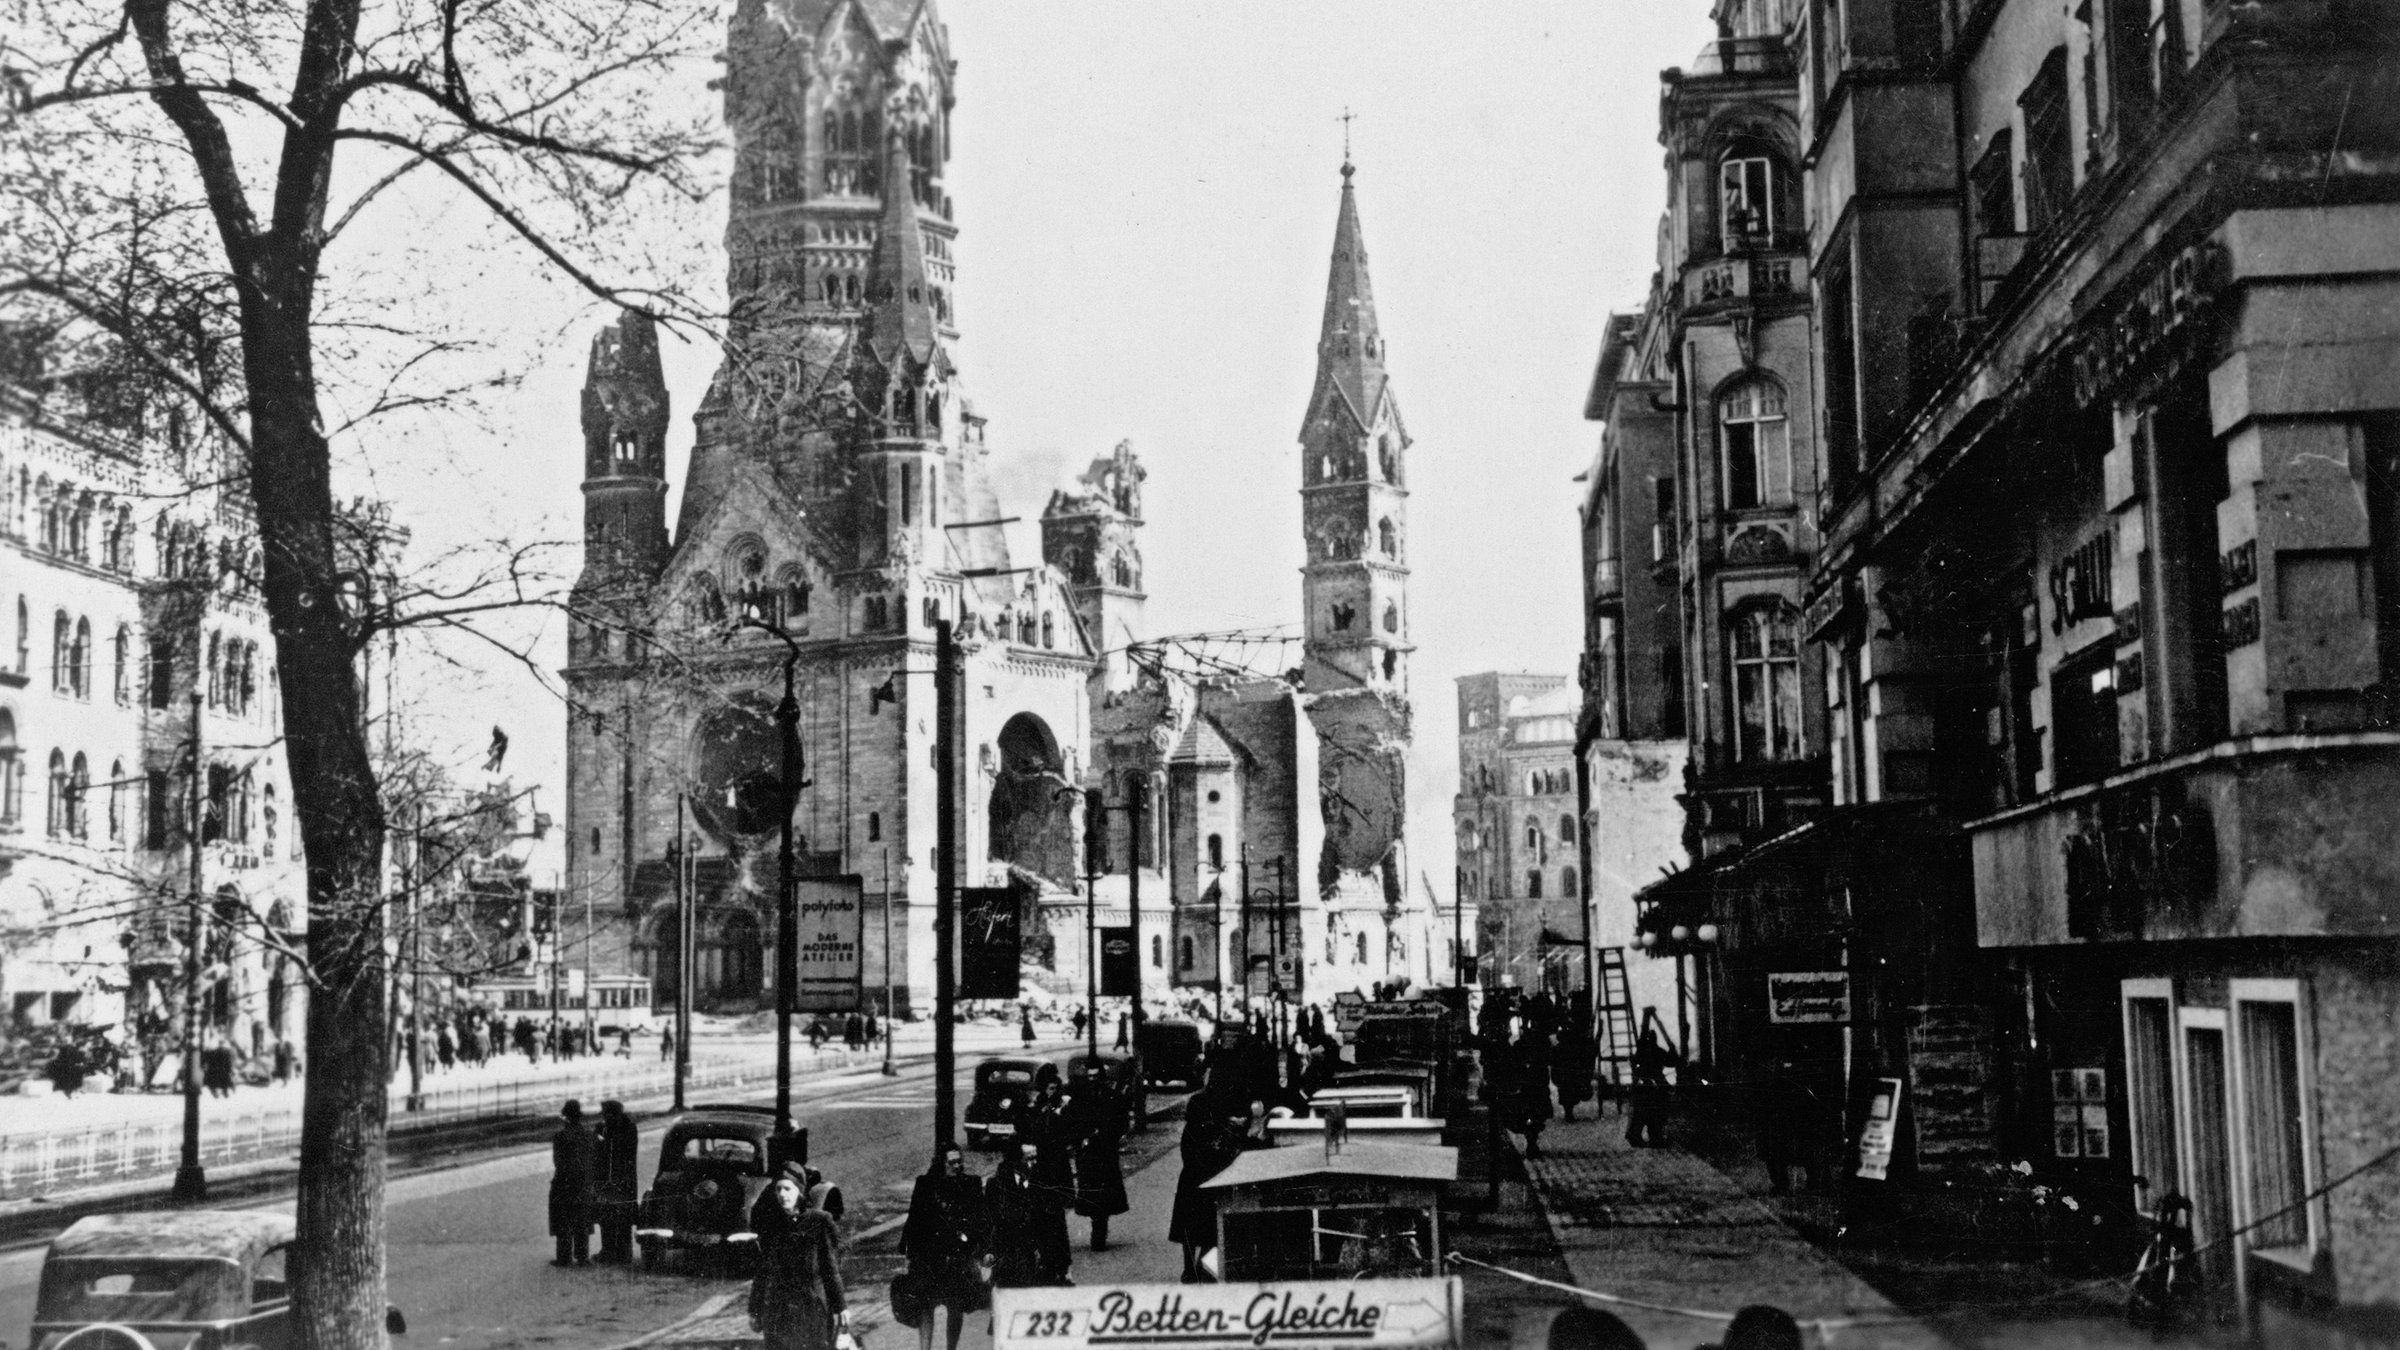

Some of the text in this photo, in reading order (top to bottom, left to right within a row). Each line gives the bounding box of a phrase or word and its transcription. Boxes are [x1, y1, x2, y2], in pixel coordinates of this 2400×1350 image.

[802, 900, 854, 917] polyfoto
[817, 932, 839, 942] DAS
[802, 942, 854, 951] MODERNE
[802, 953, 853, 962] ATELIER
[1026, 1290, 1381, 1345] 232 Betten-Gleiche
